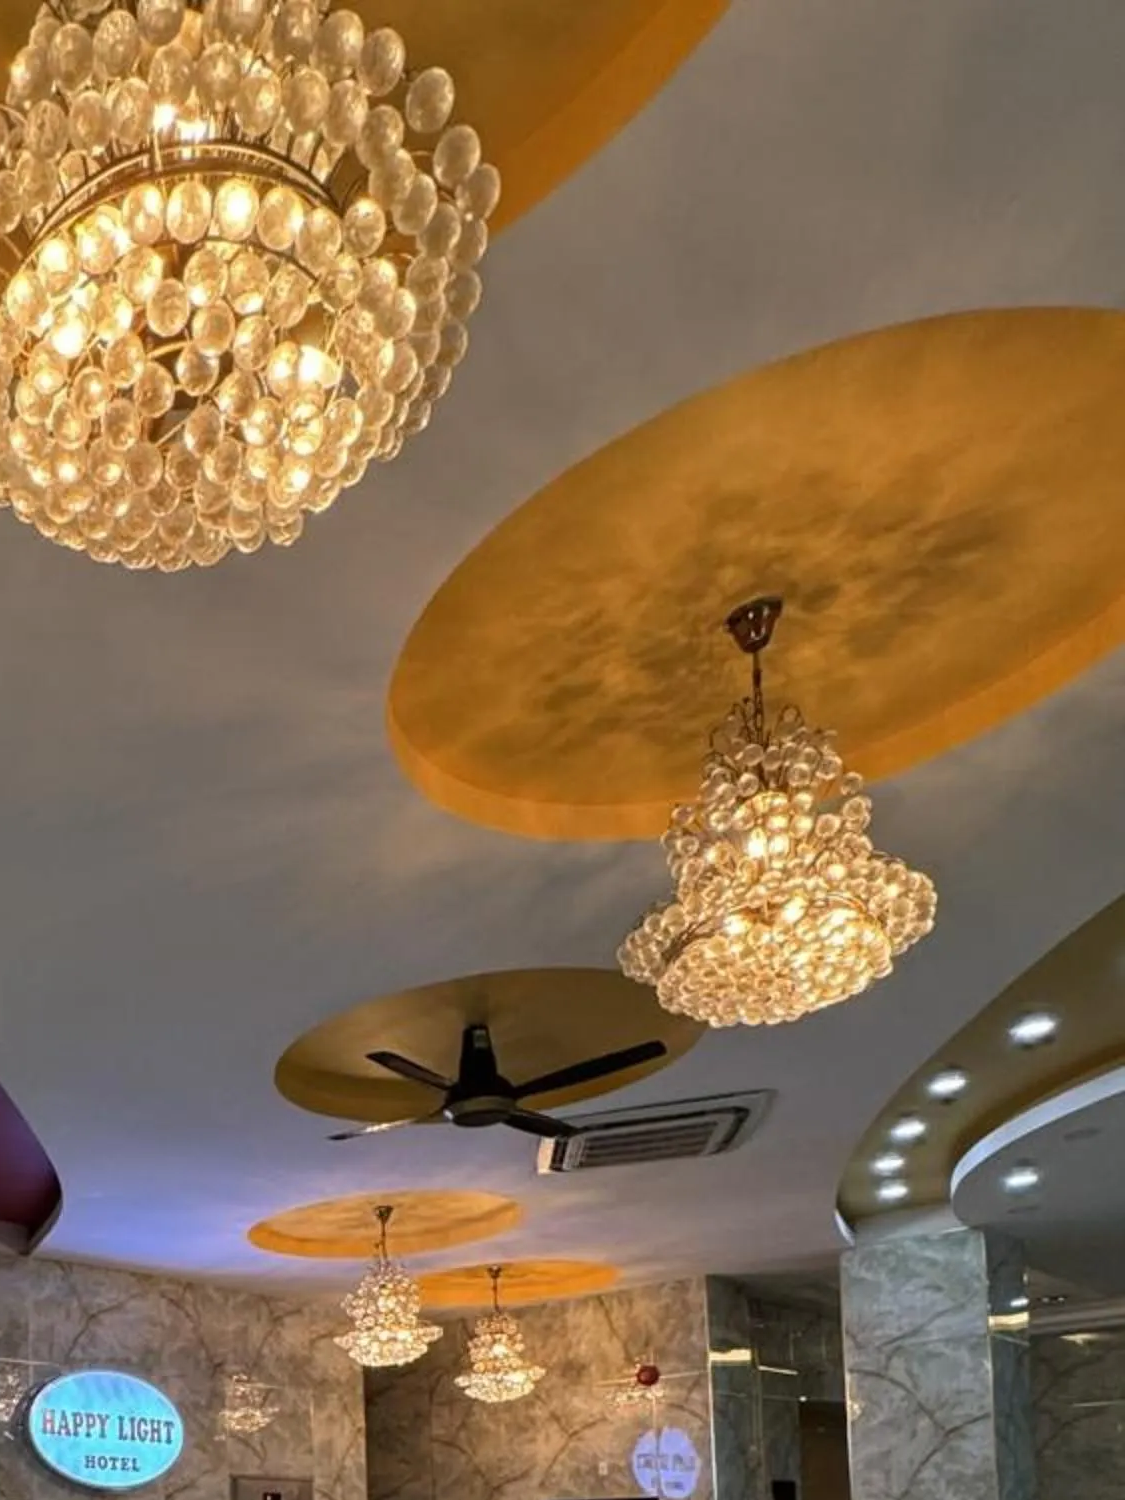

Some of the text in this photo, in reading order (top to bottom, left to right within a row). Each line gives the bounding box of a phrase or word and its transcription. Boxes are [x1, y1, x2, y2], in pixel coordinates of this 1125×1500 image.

[41, 1408, 175, 1446] HAPPY LIGHT
[83, 1454, 141, 1473] HOTEL
